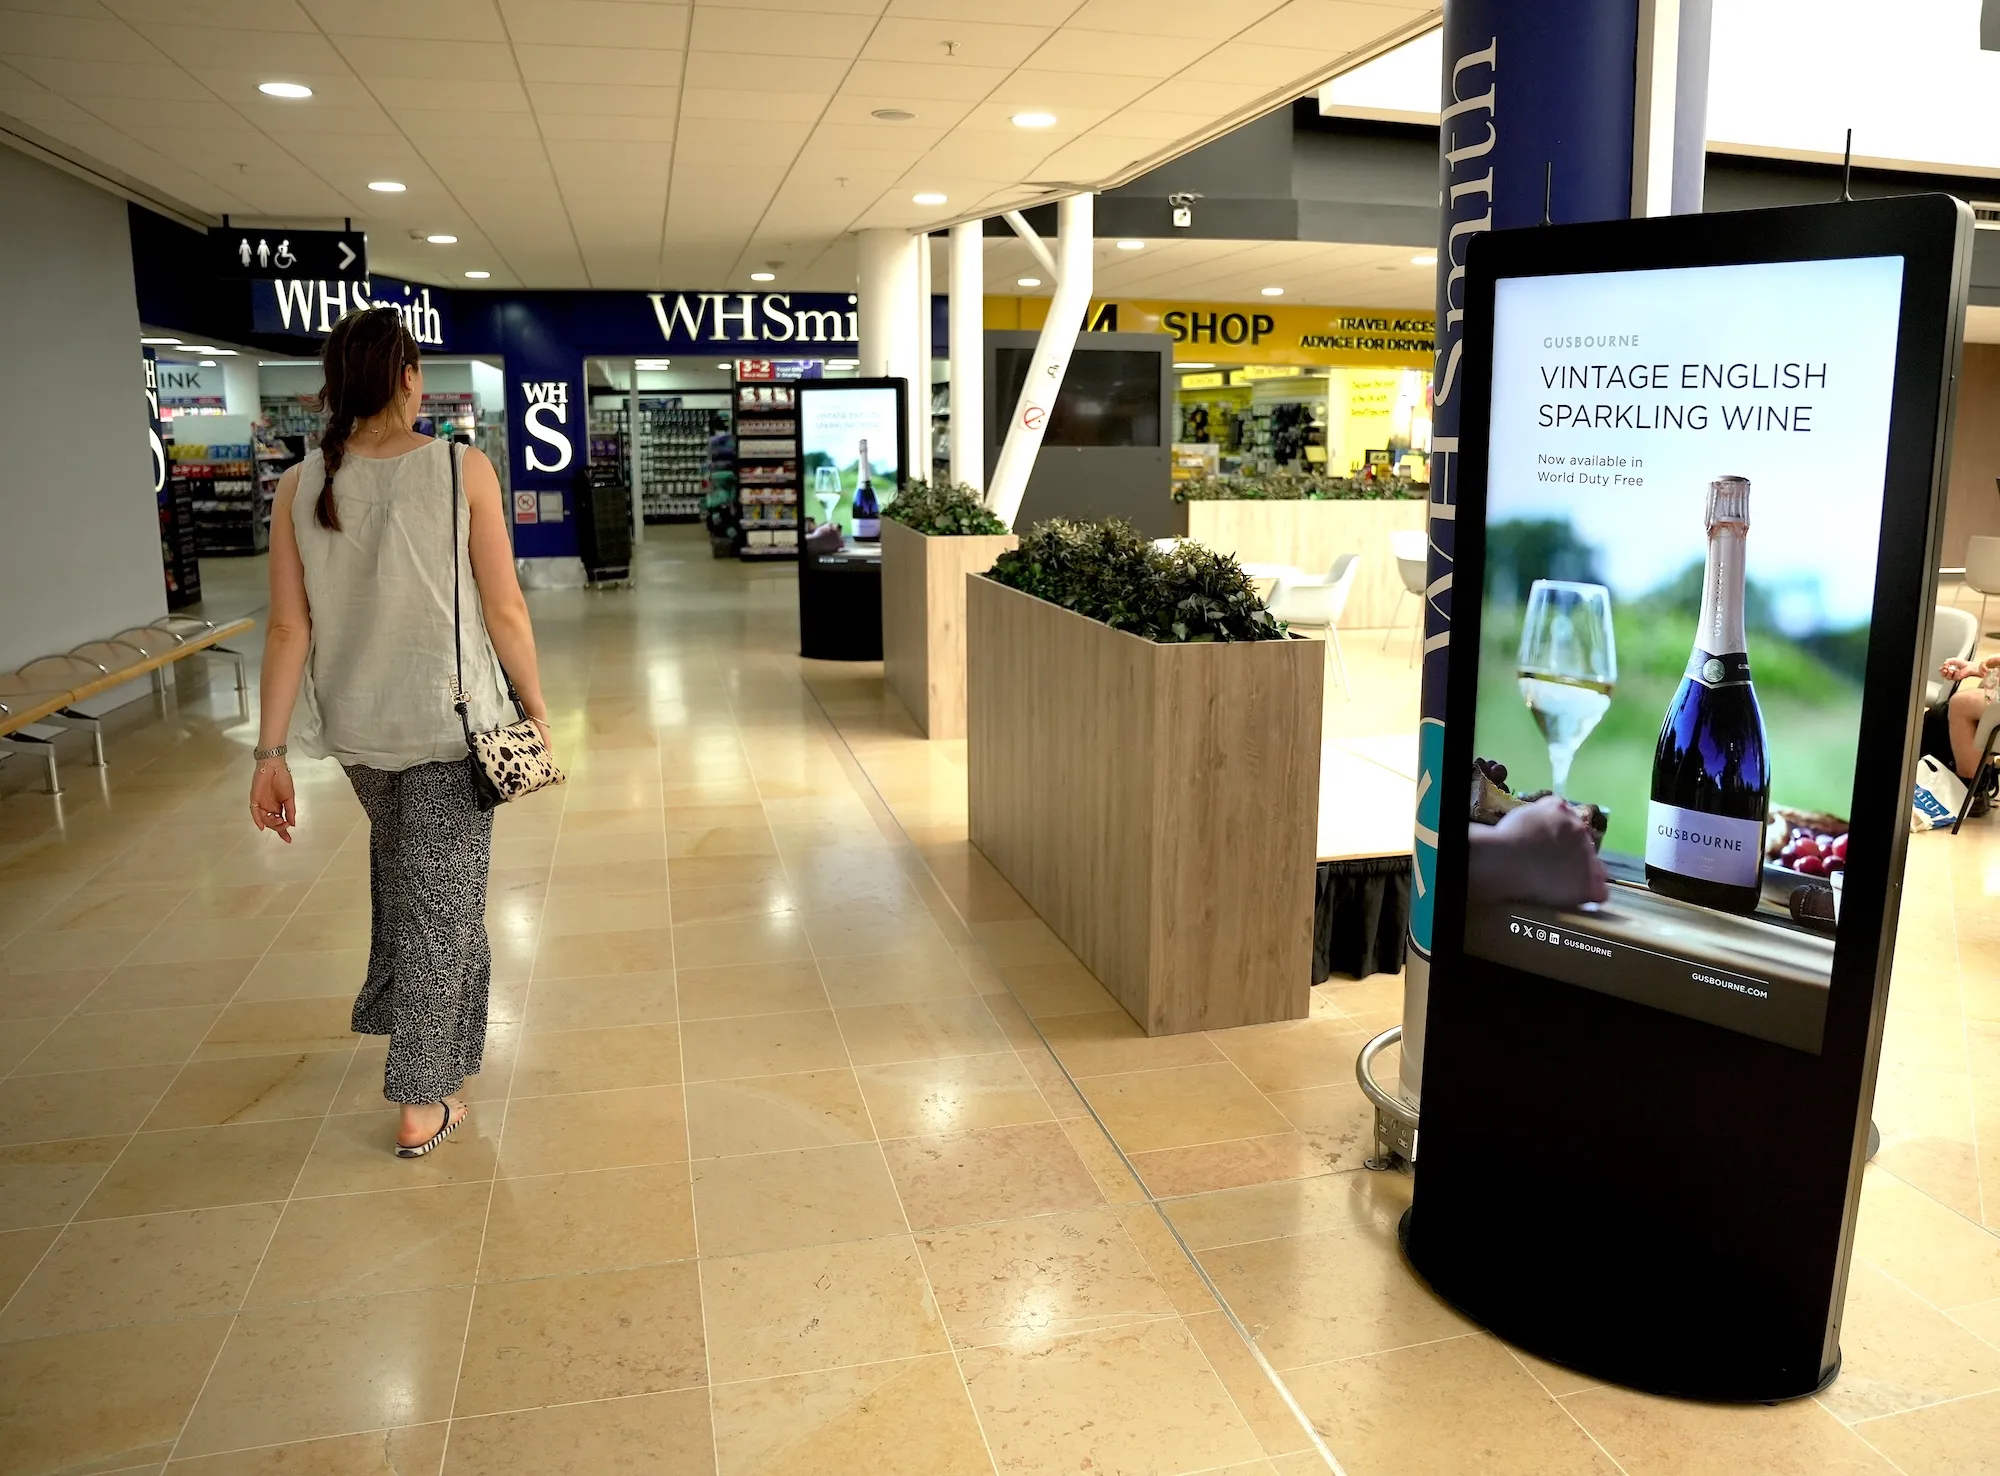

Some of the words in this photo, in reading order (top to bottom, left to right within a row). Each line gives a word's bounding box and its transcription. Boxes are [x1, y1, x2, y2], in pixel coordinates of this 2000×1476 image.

[647, 293, 859, 342] WHSmi
[1162, 311, 1275, 346] SHOP
[1338, 317, 1391, 333] TRAVEL
[1391, 318, 1436, 334] ACCES
[1299, 335, 1354, 350] ADVICE
[1356, 336, 1385, 351] FOR
[1387, 337, 1435, 352] DRIVIN
[1543, 335, 1640, 349] GUSBOURNE
[161, 372, 202, 389] INK
[1540, 364, 1670, 389] VINTAGE
[1681, 363, 1827, 389] ENGLISH
[521, 382, 568, 404] WH
[1538, 404, 1708, 430] SPARKLING
[1722, 405, 1813, 432] WINE
[525, 402, 573, 473] S
[1538, 453, 1566, 465] Now
[1569, 454, 1627, 468] available
[1631, 456, 1643, 468] in
[1537, 471, 1575, 484] World
[1579, 472, 1609, 487] Duty
[1614, 474, 1644, 487] Free
[1657, 824, 1742, 852] GUSBOURNE
[1563, 937, 1613, 958] GUSBOURNE
[1691, 971, 1768, 999] GUSBOURNE.COM
